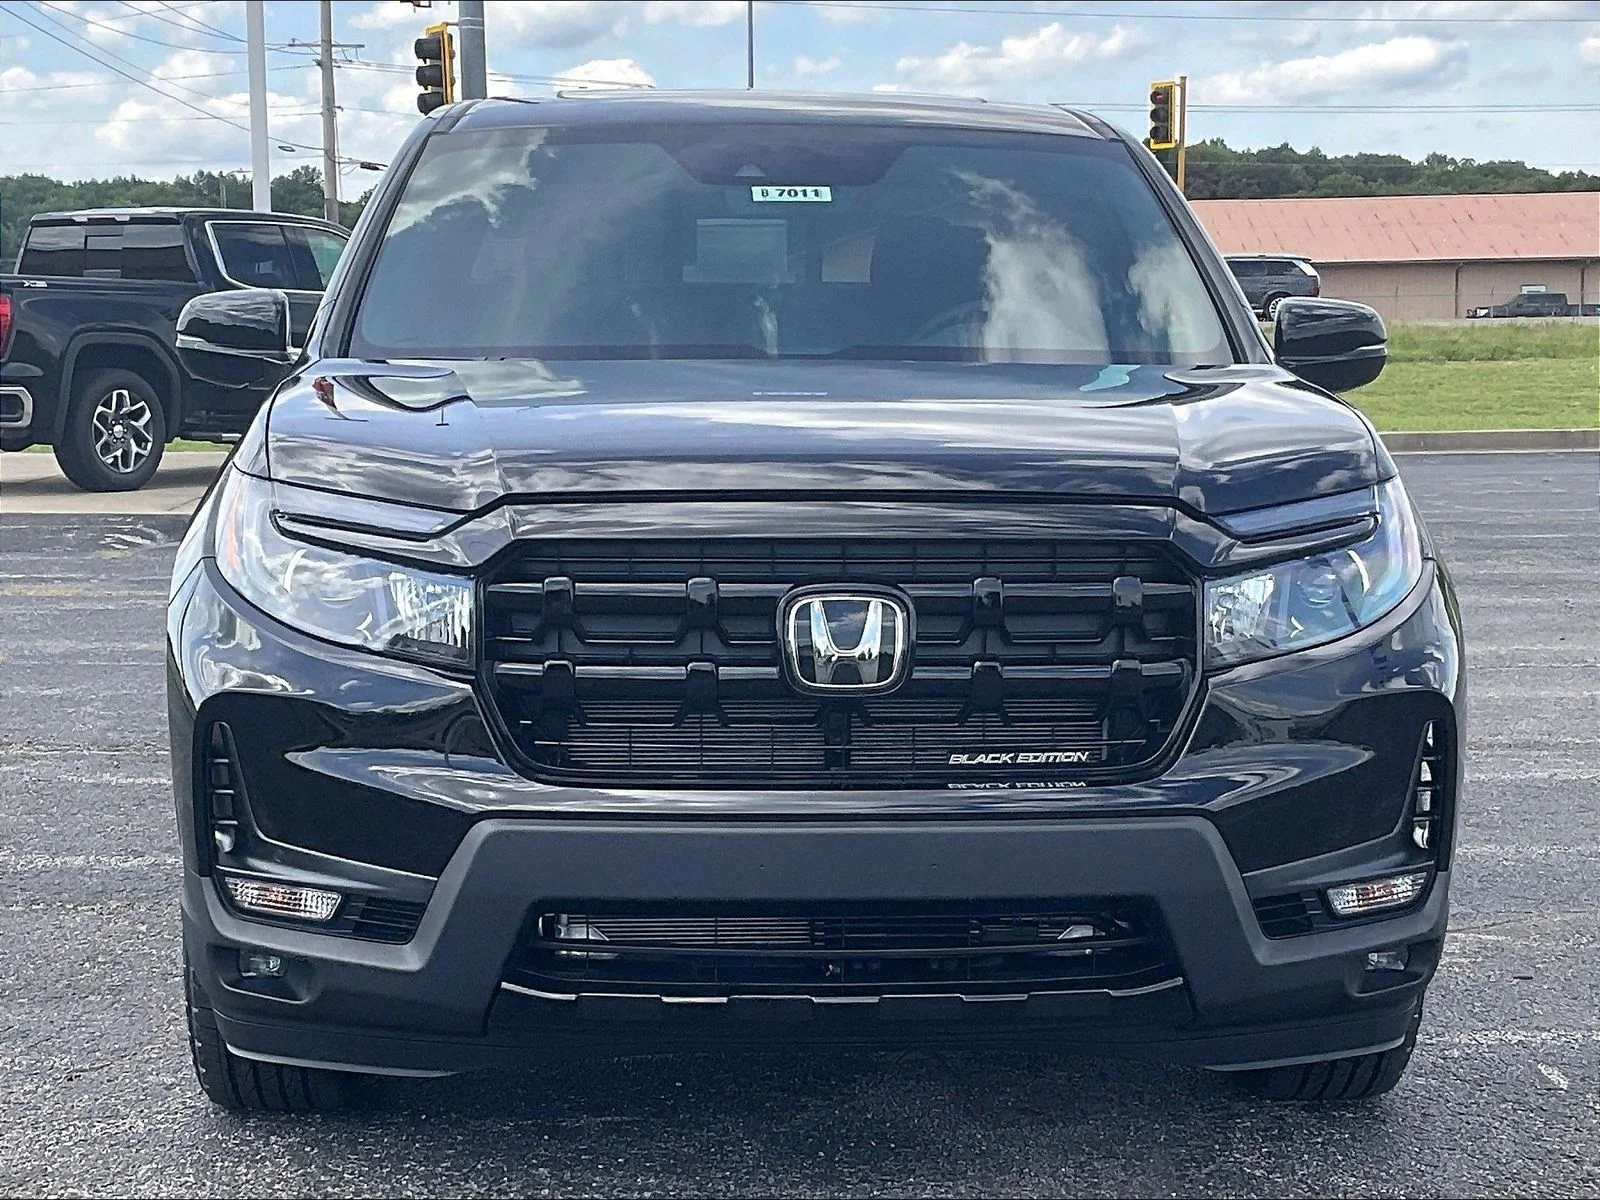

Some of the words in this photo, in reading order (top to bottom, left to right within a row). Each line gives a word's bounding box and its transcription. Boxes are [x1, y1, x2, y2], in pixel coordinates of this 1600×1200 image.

[775, 188, 820, 198] 7011
[948, 752, 1015, 765] BLACK
[1015, 751, 1090, 764] EDITION
